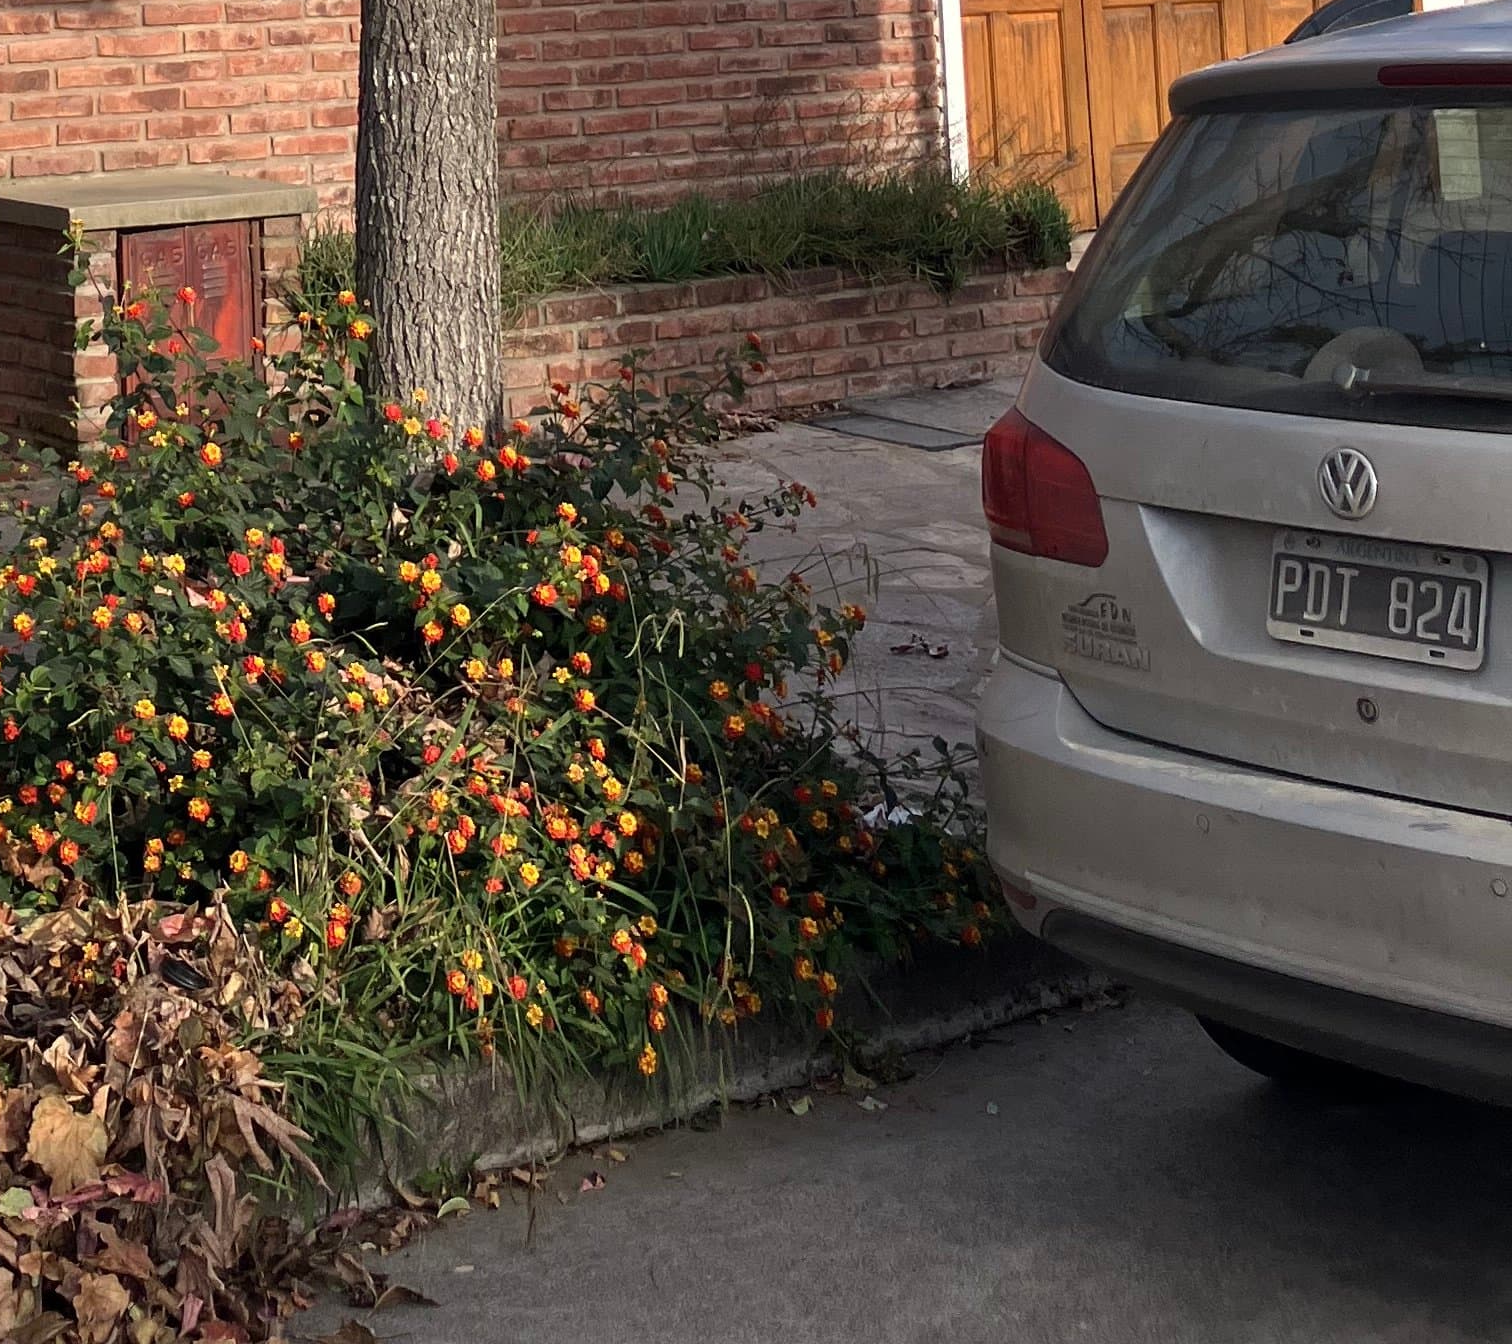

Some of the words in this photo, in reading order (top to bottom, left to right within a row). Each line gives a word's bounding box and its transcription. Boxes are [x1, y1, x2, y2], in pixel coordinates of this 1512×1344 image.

[196, 239, 237, 262] GAS
[1276, 559, 1361, 627] PDT
[1388, 576, 1473, 645] 824
